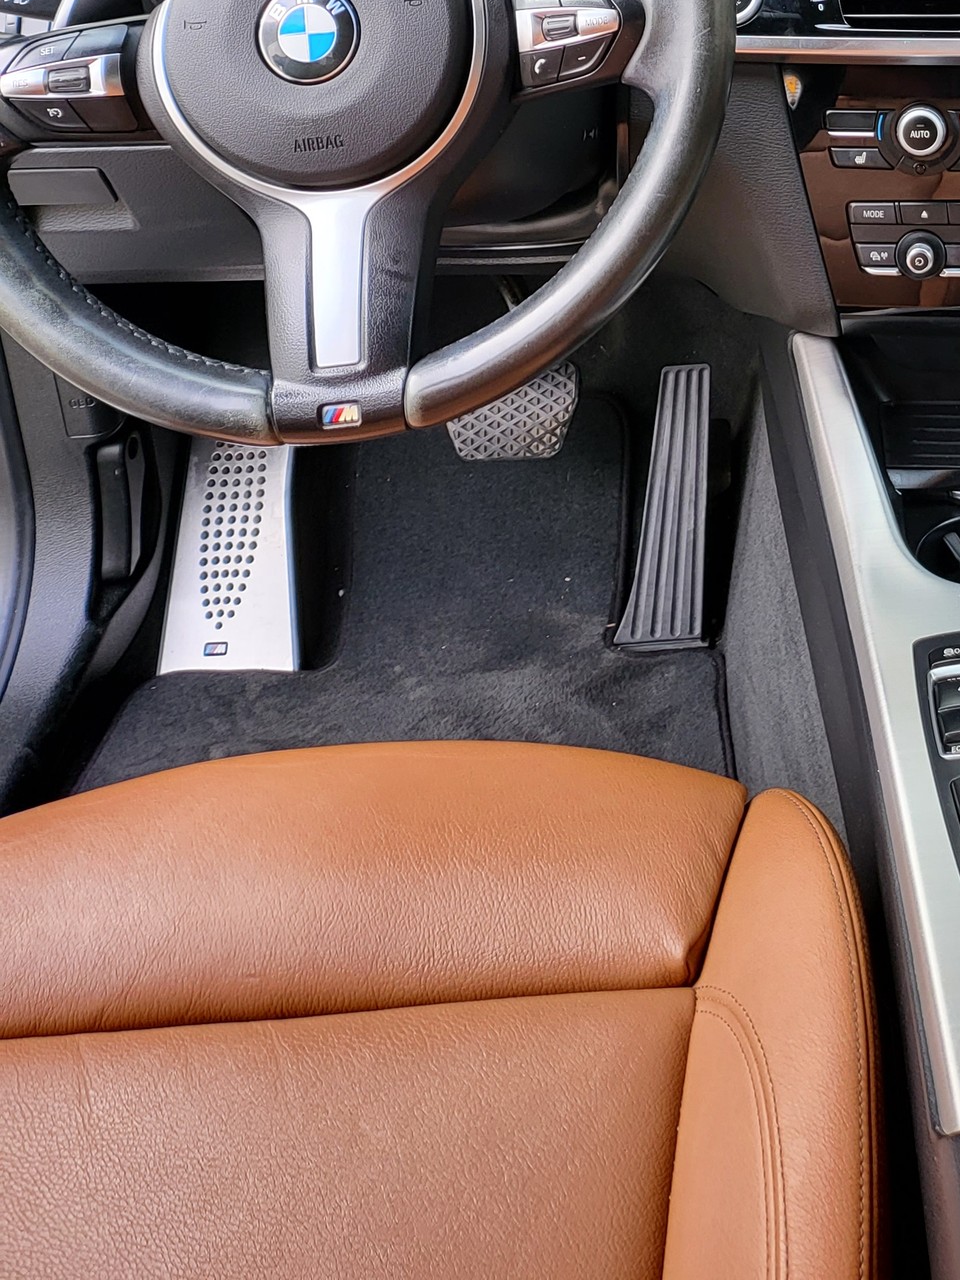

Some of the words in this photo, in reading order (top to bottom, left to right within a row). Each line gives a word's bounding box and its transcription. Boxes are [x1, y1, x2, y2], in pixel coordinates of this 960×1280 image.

[40, 46, 55, 56] SET
[909, 129, 930, 139] AUTO
[293, 134, 344, 153] AIRBAG
[862, 209, 885, 219] MODE
